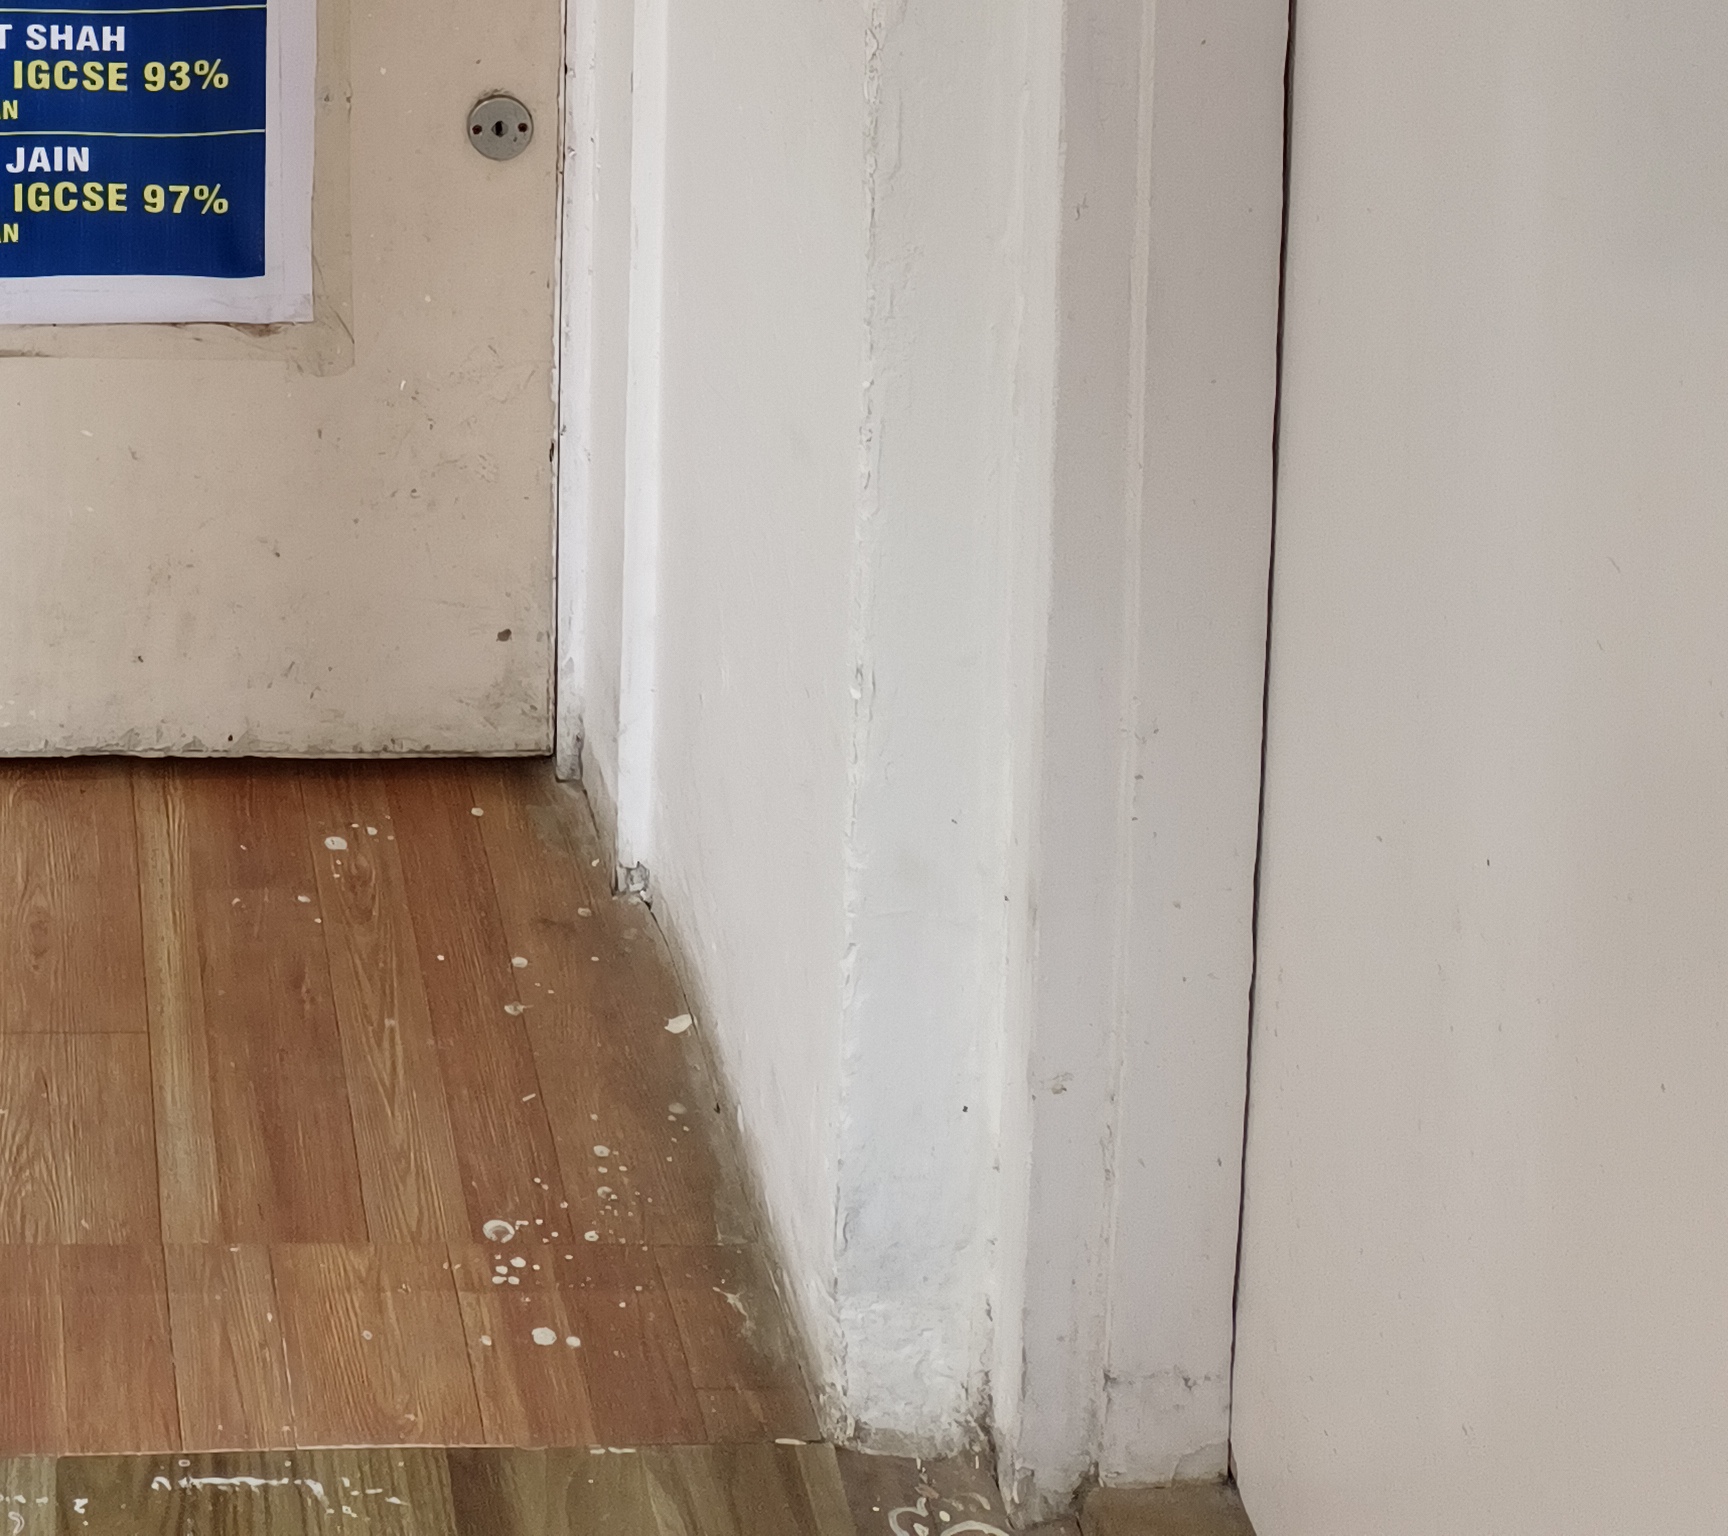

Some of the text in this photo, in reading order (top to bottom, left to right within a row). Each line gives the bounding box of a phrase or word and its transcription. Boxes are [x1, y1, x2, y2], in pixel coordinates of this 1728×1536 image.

[25, 23, 126, 52] SHAH
[13, 59, 128, 92] IGCSE
[143, 58, 229, 92] 93%
[5, 146, 90, 174] JAIN
[14, 181, 128, 213] IGCSE
[143, 183, 229, 215] 97%
